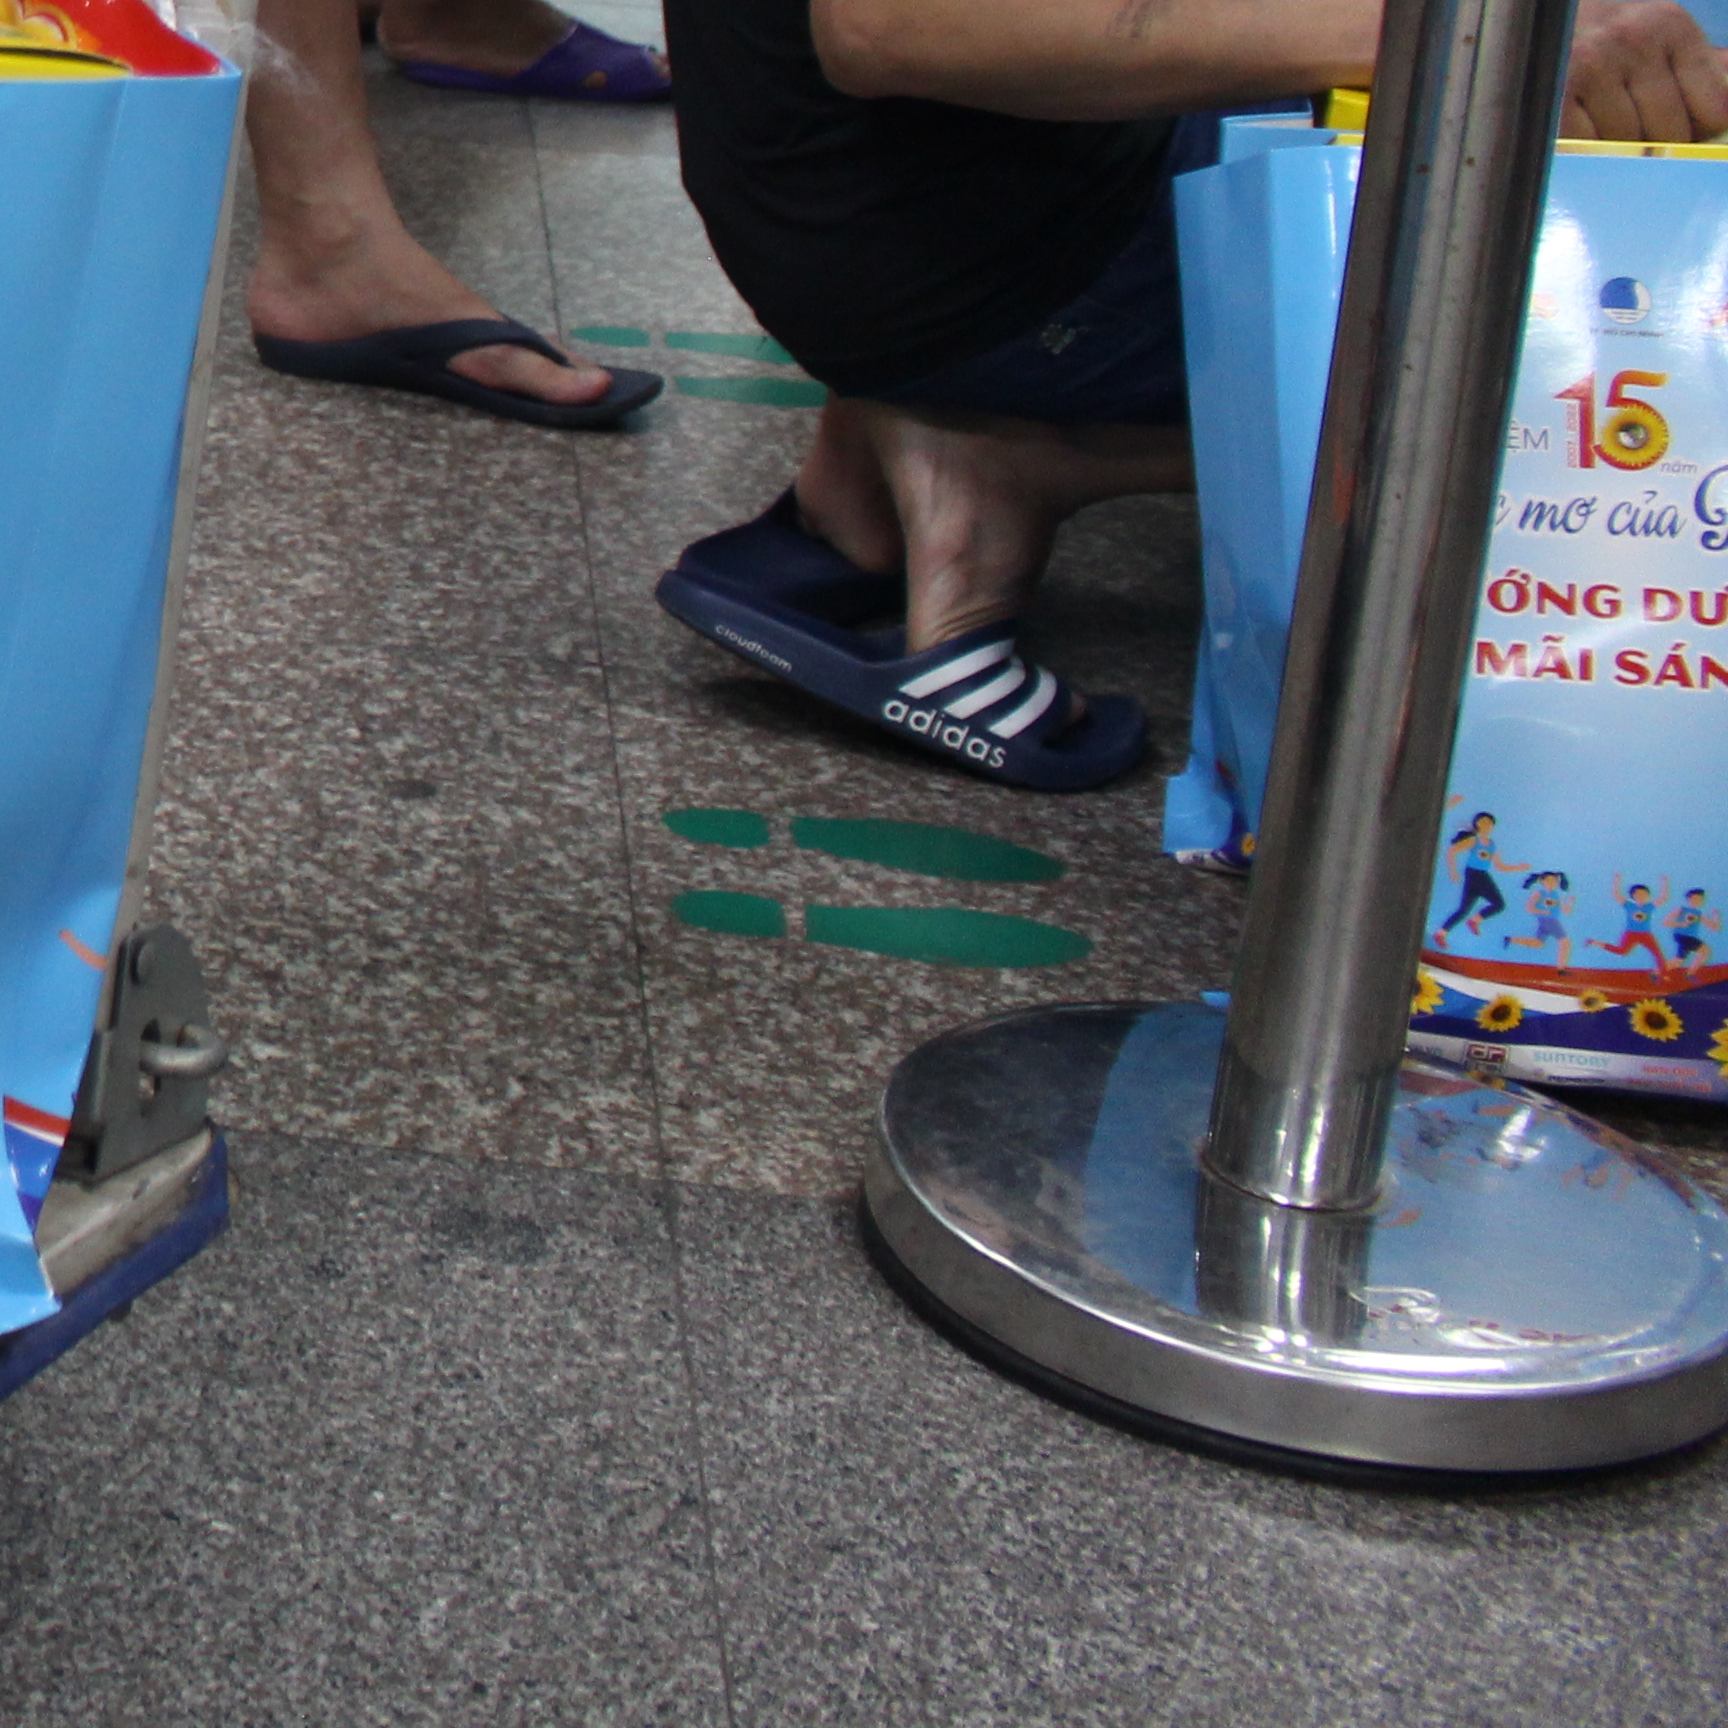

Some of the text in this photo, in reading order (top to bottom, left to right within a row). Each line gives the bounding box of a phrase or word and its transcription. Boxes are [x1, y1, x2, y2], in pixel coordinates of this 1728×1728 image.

[1553, 370, 1670, 472] 15
[1518, 494, 1598, 534] mơ
[1607, 489, 1687, 539] của
[1475, 634, 1728, 690] MÃI SÁN
[883, 698, 1007, 769] adidas
